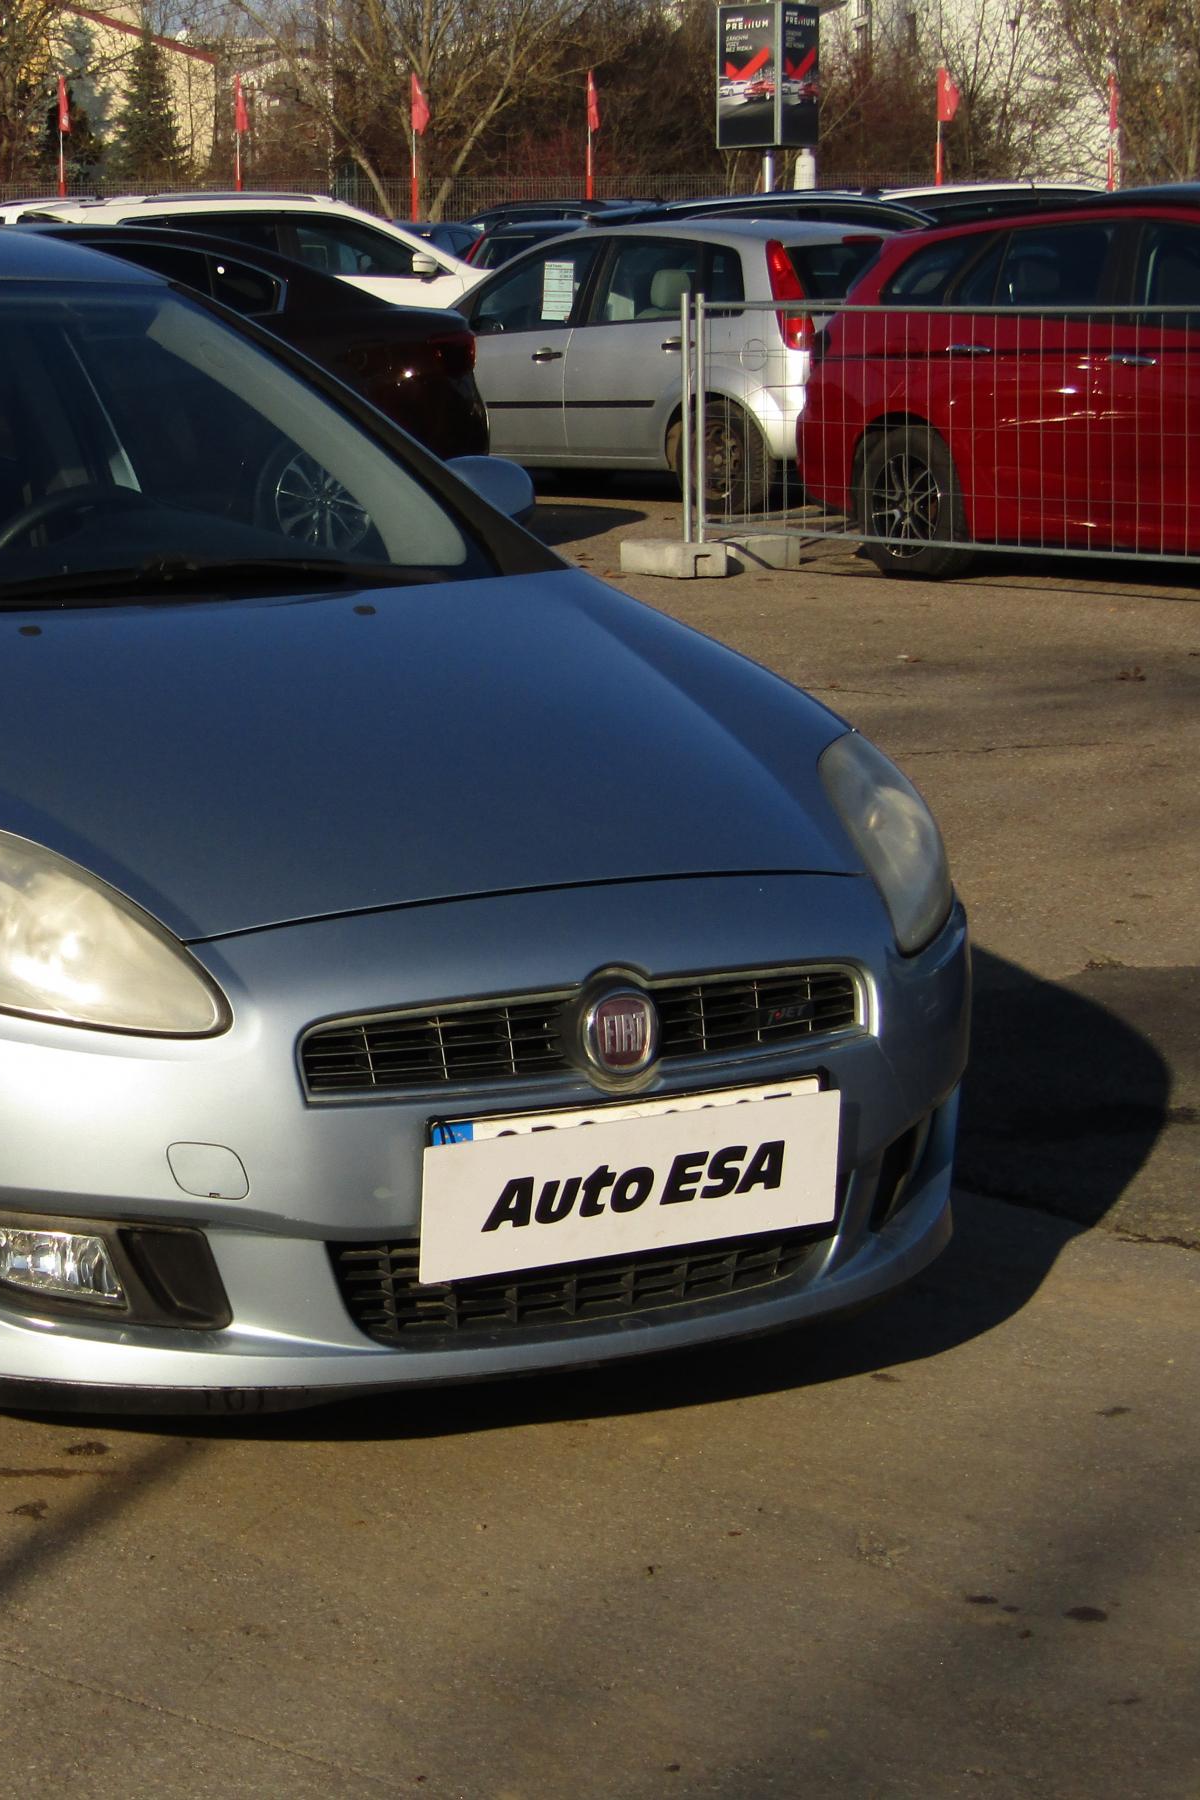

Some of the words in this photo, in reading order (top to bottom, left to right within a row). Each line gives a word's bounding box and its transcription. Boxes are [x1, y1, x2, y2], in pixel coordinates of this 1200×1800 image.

[725, 19, 769, 31] PREMIUM
[603, 1012, 645, 1054] FIAT
[481, 1165, 655, 1232] Auto
[660, 1140, 785, 1205] ESA
